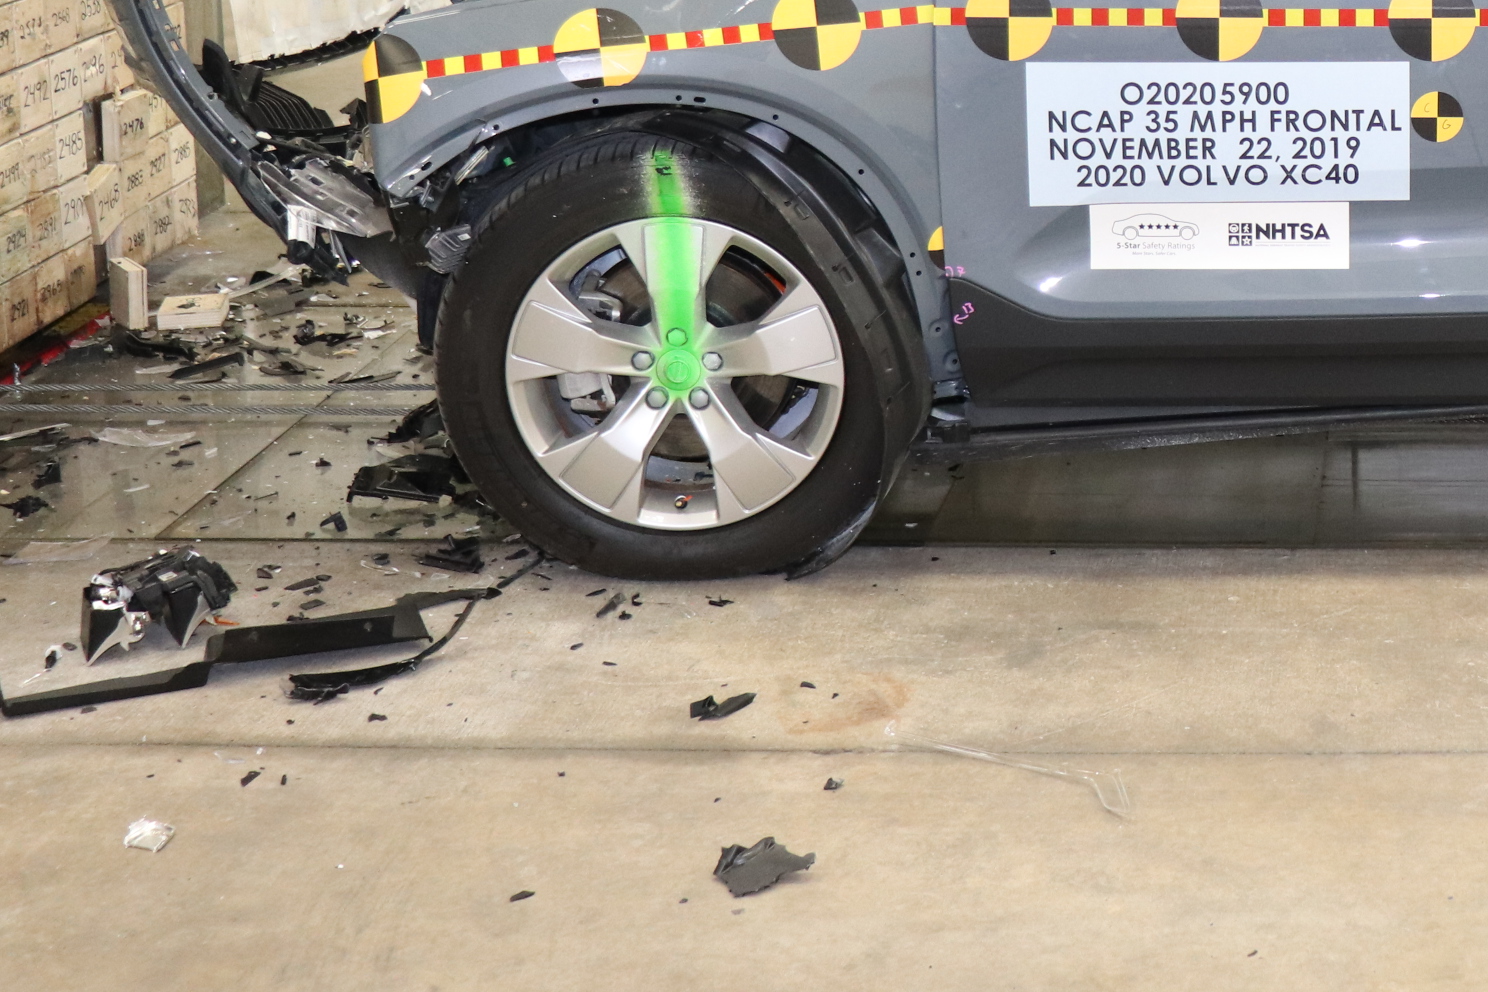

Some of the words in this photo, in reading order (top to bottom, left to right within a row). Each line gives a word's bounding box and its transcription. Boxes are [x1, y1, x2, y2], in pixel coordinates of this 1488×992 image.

[24, 79, 50, 107] 2492
[54, 68, 79, 93] 2576
[1048, 110, 1134, 133] NCAP
[1145, 110, 1179, 133] 35
[1190, 111, 1257, 133] MPH
[1270, 109, 1402, 132] FRONTAL
[59, 131, 83, 159] 2485
[1050, 138, 1217, 160] NOVEMBER
[1239, 137, 1281, 162] 22,
[1292, 137, 1361, 159] 2019
[1077, 165, 1146, 188] 2020
[1157, 165, 1269, 187] VOLVO
[1280, 164, 1360, 186] XC40
[1255, 223, 1330, 240] NHTSA
[1142, 242, 1165, 251] Safety
[1167, 242, 1196, 251] Ratings
